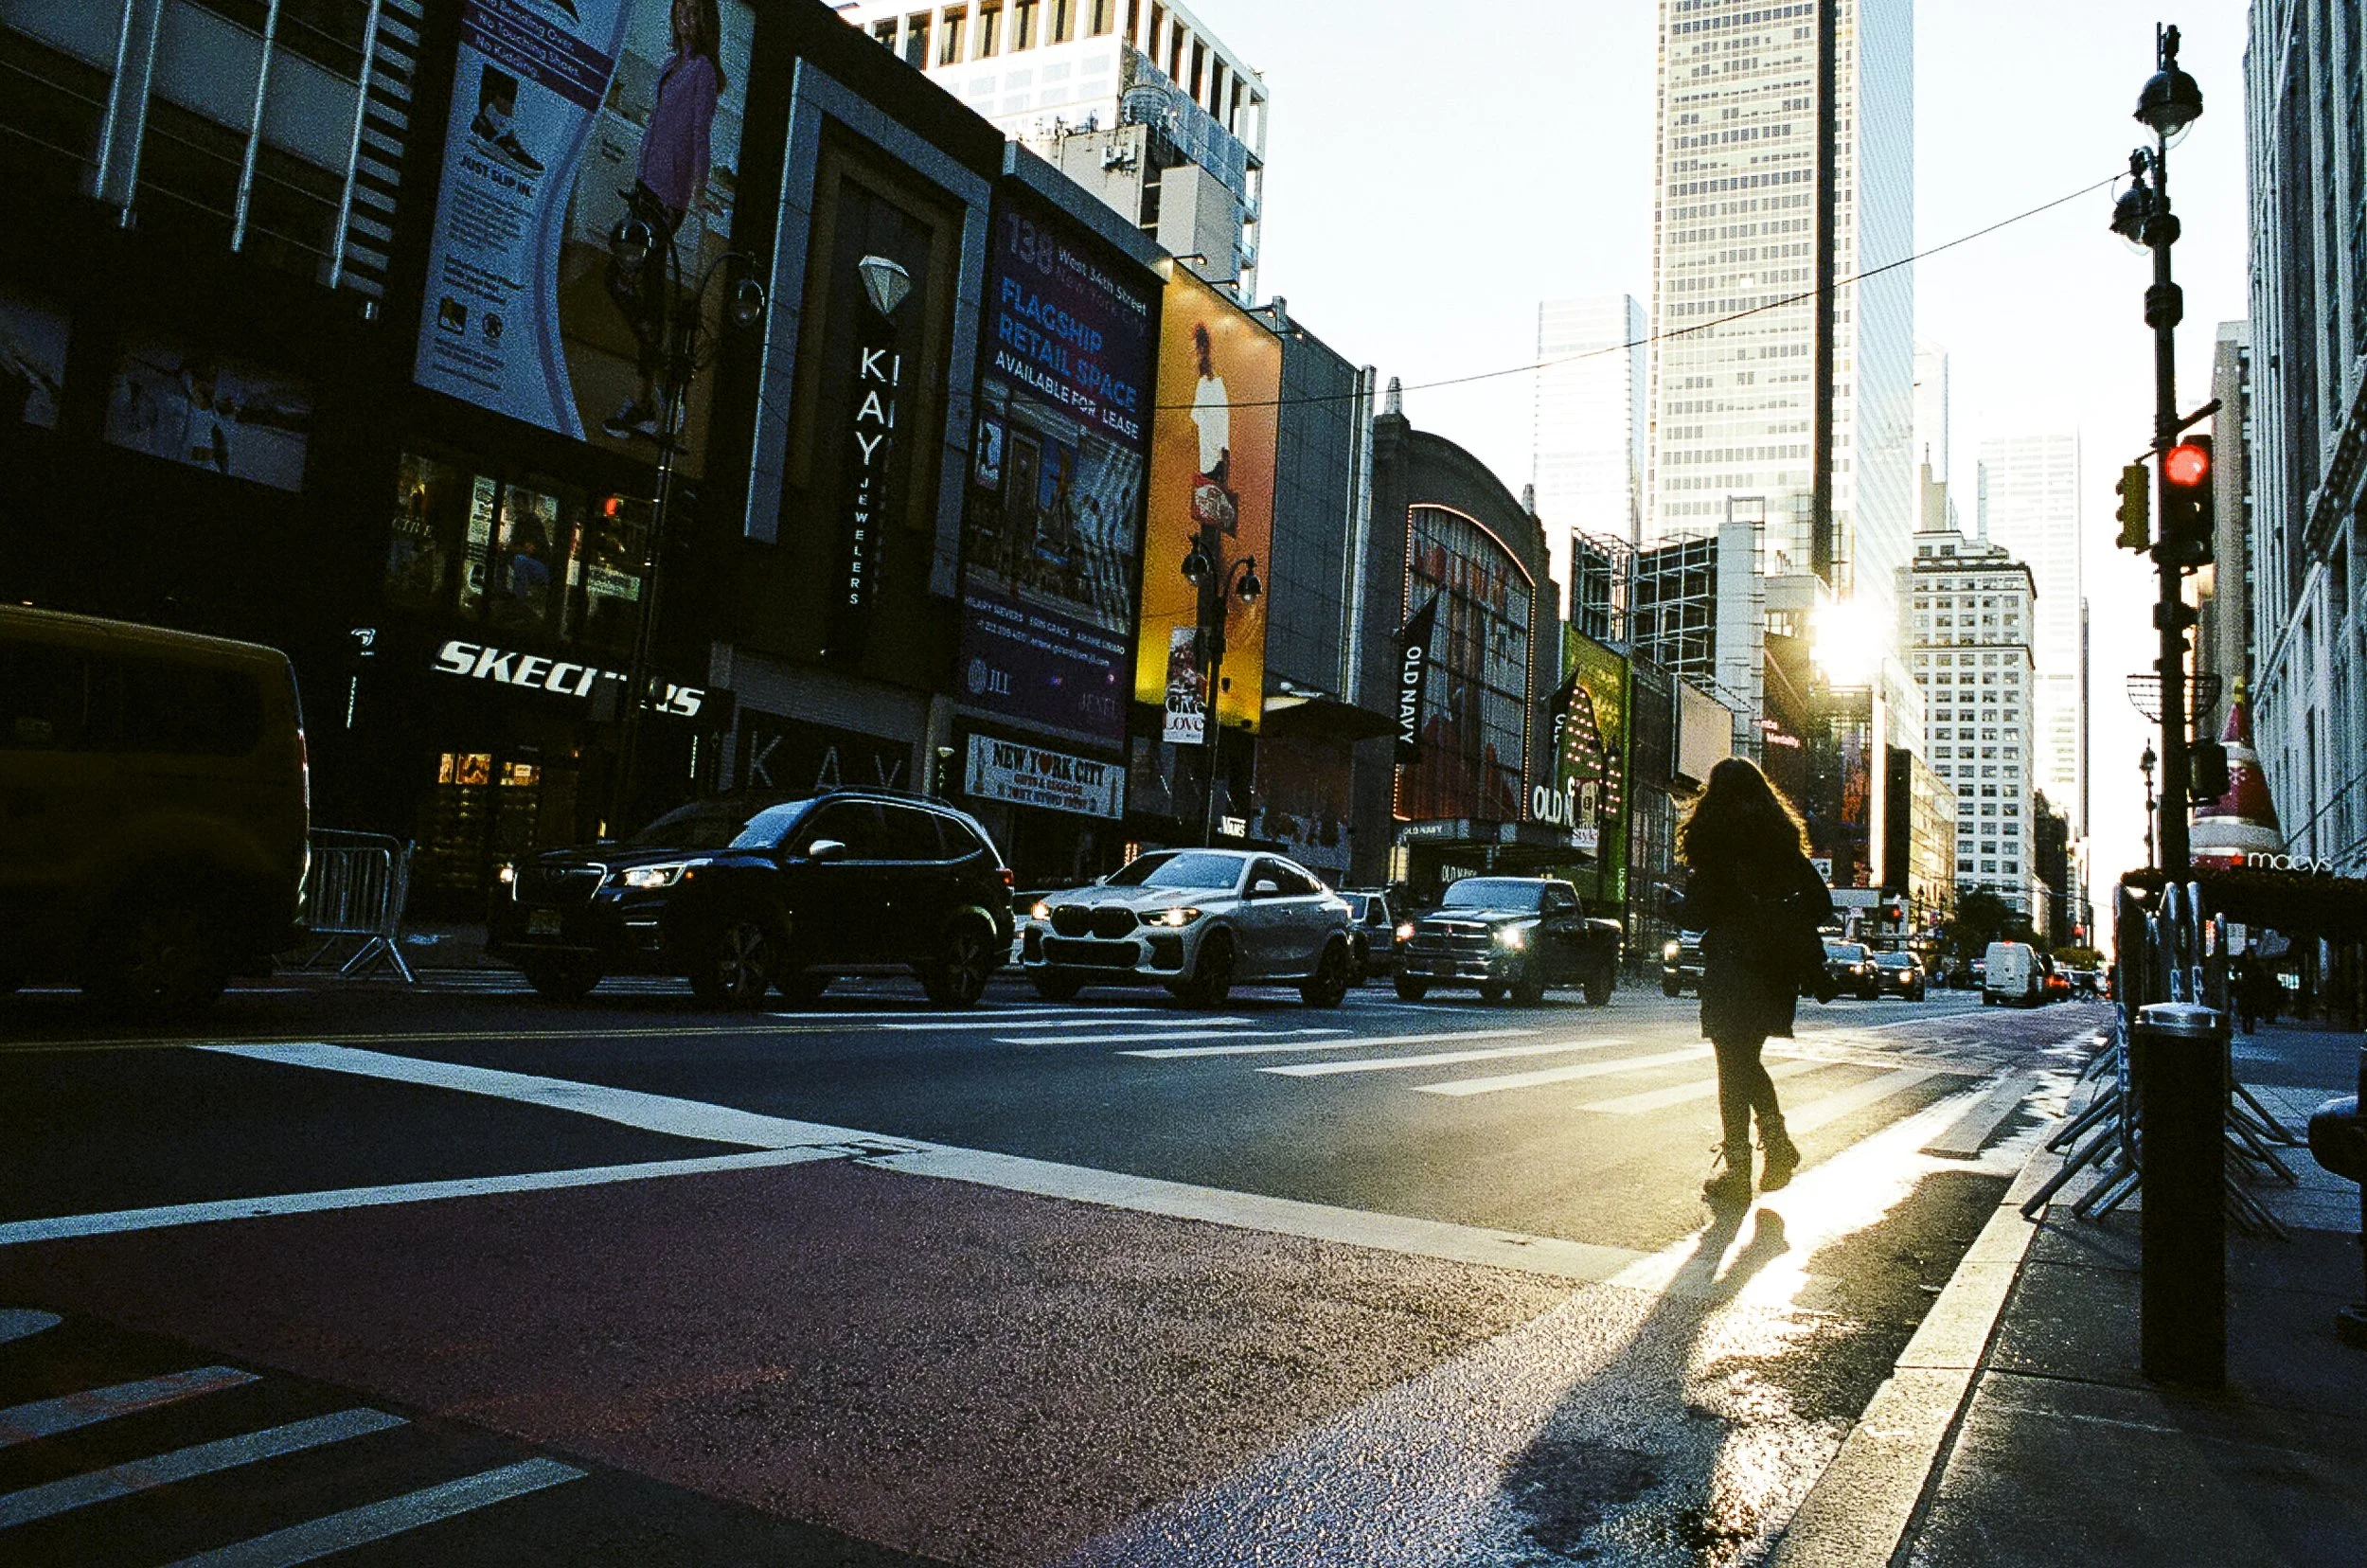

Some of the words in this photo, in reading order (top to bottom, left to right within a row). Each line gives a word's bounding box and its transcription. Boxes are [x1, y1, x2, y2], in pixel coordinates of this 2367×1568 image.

[474, 33, 492, 51] No
[477, 11, 494, 28] No
[459, 155, 489, 177] JUST
[490, 169, 516, 189] SLIP
[1008, 211, 1053, 275] 138
[1058, 247, 1087, 278] West
[1089, 271, 1114, 294] 34th
[1115, 284, 1148, 317] Street
[1003, 276, 1104, 354] FLAGSHIP
[999, 312, 1072, 379] RETAIL
[1077, 358, 1138, 415] SPACE
[856, 346, 885, 466] KAY
[995, 349, 1070, 405] AVAILABLE
[1071, 389, 1097, 419] FOR
[1101, 407, 1140, 440] LEASE
[849, 477, 869, 604] JEWELERS
[1402, 645, 1422, 686] OLD
[1399, 688, 1421, 745] NAVY
[993, 740, 1026, 772] NEW
[1075, 759, 1106, 787] CITY
[1533, 784, 1562, 825] OLD
